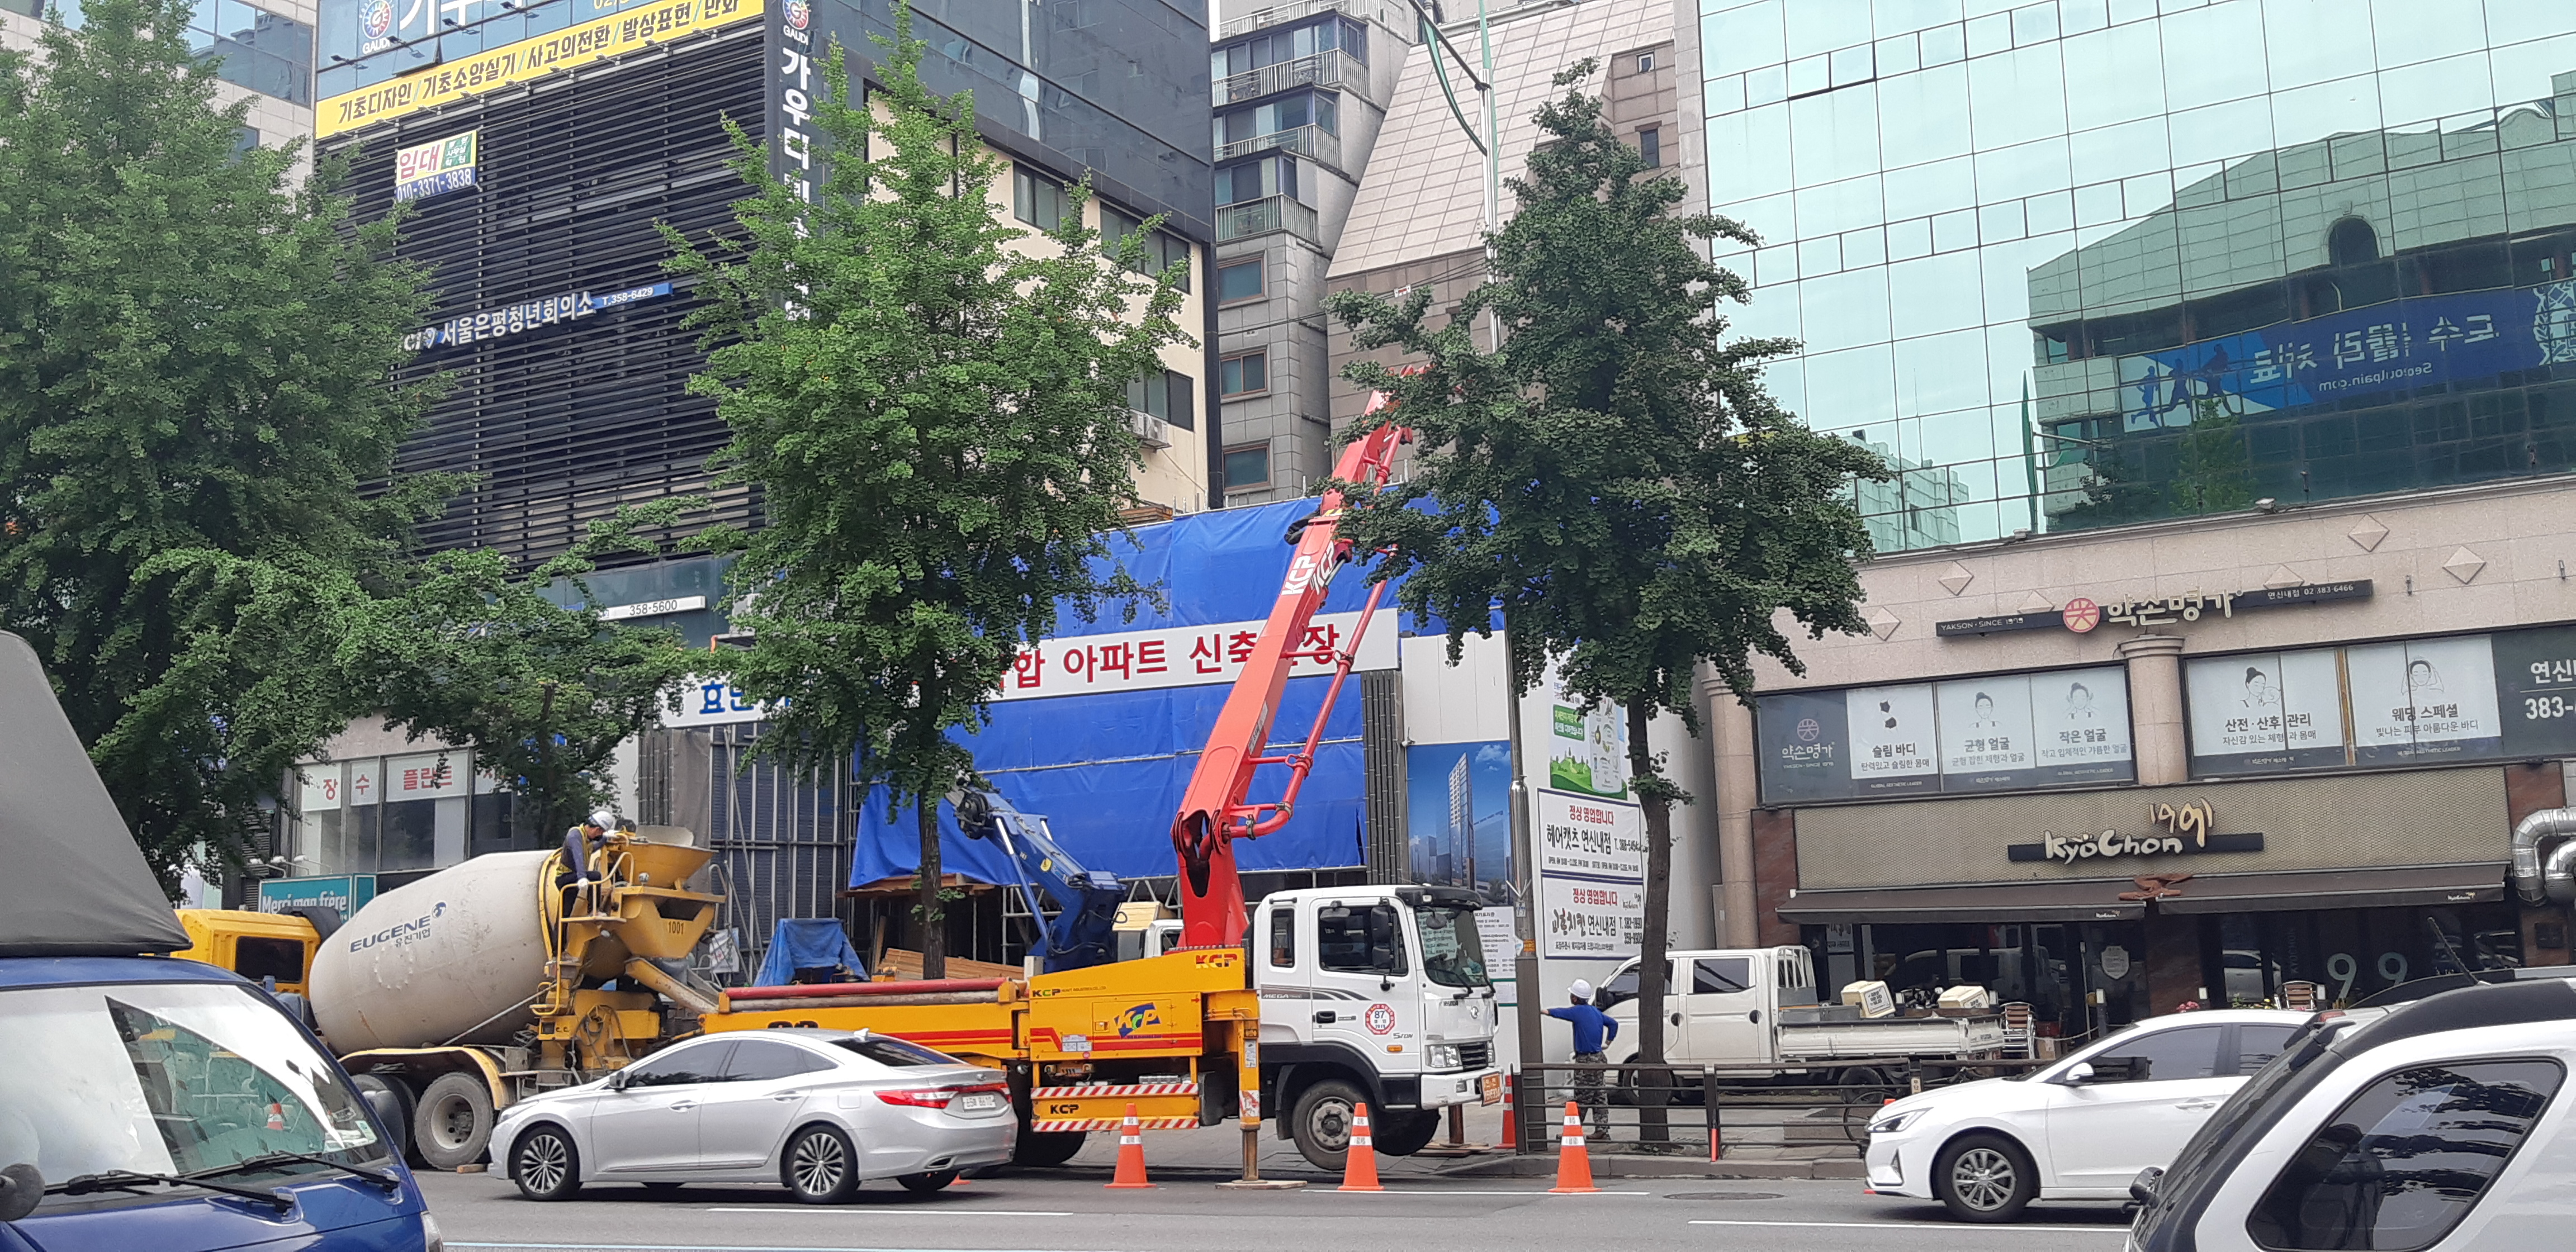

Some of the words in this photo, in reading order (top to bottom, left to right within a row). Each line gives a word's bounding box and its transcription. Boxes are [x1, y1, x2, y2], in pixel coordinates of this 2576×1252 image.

[783, 25, 808, 45] GAUDI
[400, 144, 441, 179] 임대
[397, 168, 471, 202] 010-3371-3838
[441, 291, 595, 346] 서울은평청년회의소
[1281, 555, 1317, 595] KCP
[1309, 540, 1334, 595] KCP
[2108, 586, 2234, 627] 약손명가
[2267, 590, 2300, 600] 연신내점
[1940, 623, 1973, 631] YAKSON
[1063, 640, 1168, 684] 아파트
[2392, 706, 2416, 722] 웨딩
[2421, 703, 2459, 718] 스페셜
[2525, 696, 2576, 719] 383-
[2287, 713, 2311, 728] 관리
[2376, 727, 2402, 737] 빛나는
[2423, 721, 2459, 733] 아름다운
[2461, 719, 2479, 731] 바디
[1964, 739, 1985, 753] 균형
[1988, 737, 2010, 751] 얼굴
[2059, 730, 2081, 744] 작은
[2084, 728, 2106, 742] 얼굴
[2223, 735, 2247, 746] 자신감
[2249, 733, 2266, 744] 있는
[2300, 729, 2317, 740] 몸매
[1782, 743, 1833, 760] 약손명가
[1872, 744, 1892, 758] 슬림
[1896, 742, 1916, 756] 바디
[1861, 761, 1890, 772] 탄력있고
[1569, 805, 1582, 822] 정상
[1583, 807, 1614, 826] 영업합니다
[1581, 829, 1611, 855] 연신내점
[1573, 888, 1586, 904] 정상
[1587, 889, 1618, 906] 영업합니다
[350, 915, 431, 953] EUGENE
[668, 921, 684, 935] 1001
[1588, 914, 1616, 936] 연신내점
[395, 927, 431, 948] 유진기업
[1195, 954, 1238, 969] KCP
[1032, 988, 1061, 997] KCP
[1374, 1011, 1385, 1019] 87
[1050, 1104, 1079, 1114] KCP
